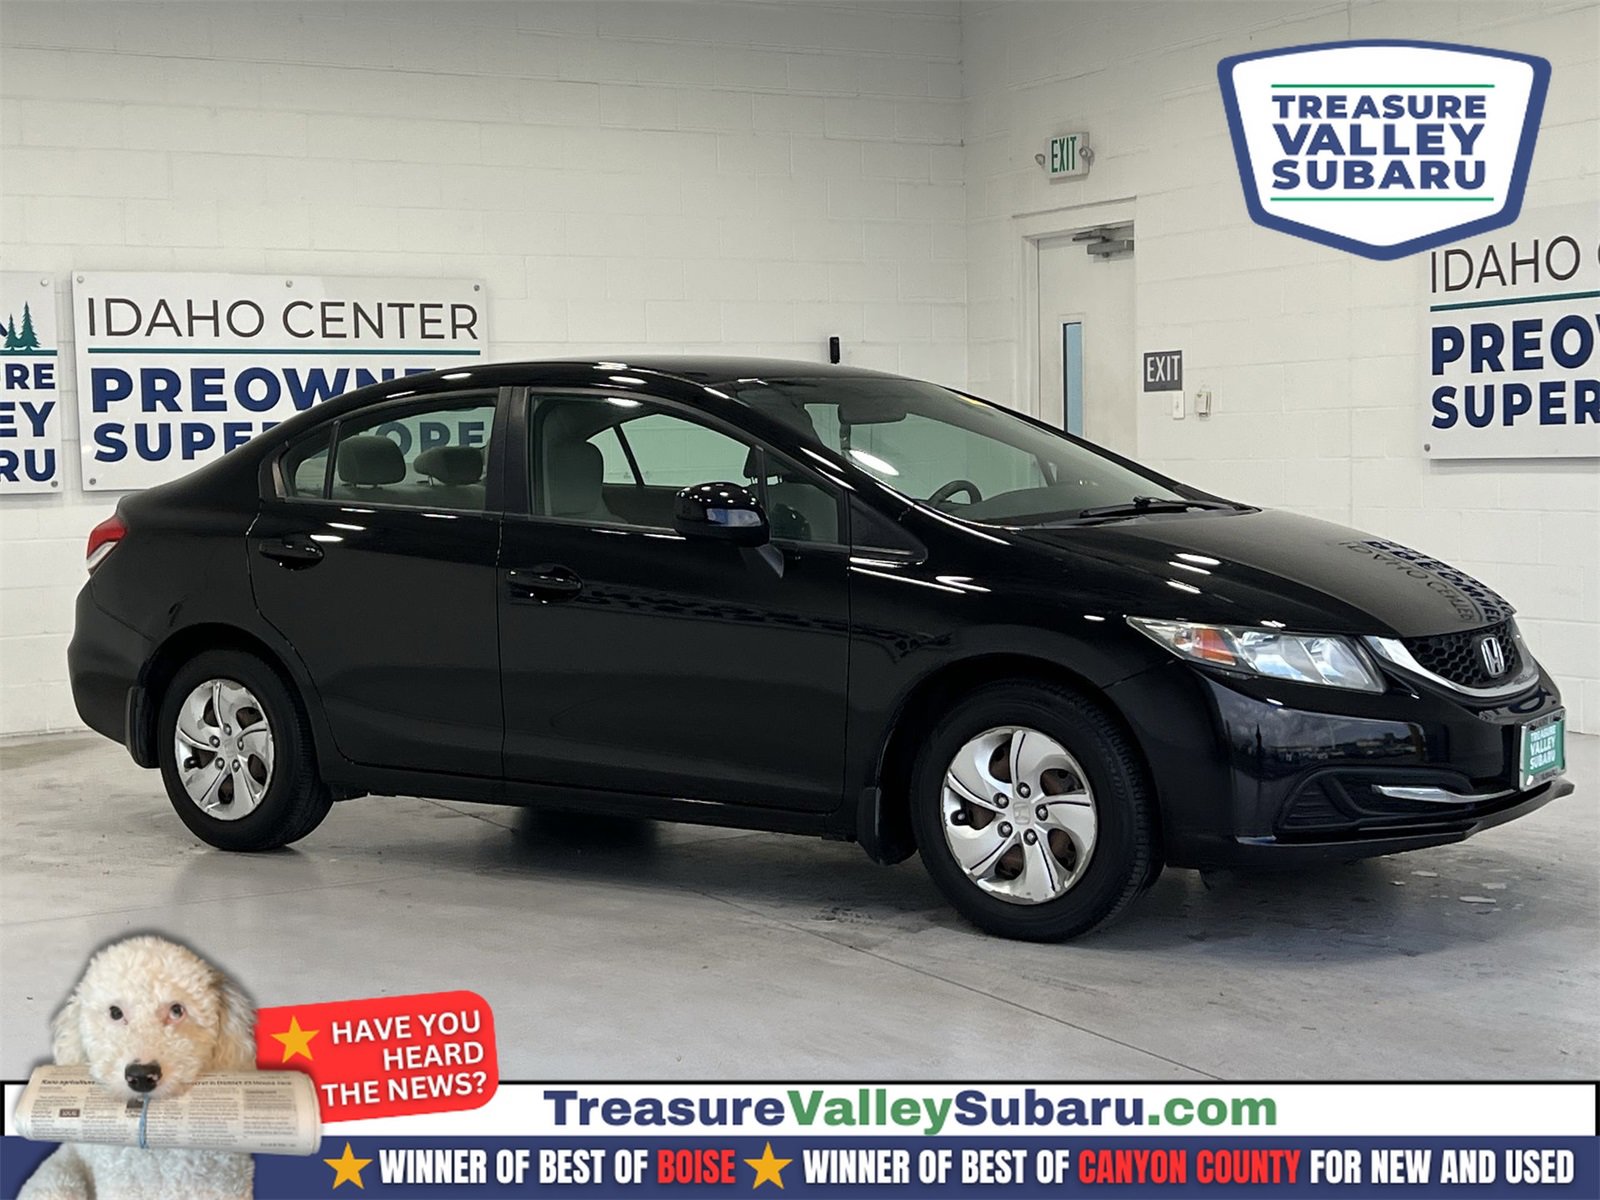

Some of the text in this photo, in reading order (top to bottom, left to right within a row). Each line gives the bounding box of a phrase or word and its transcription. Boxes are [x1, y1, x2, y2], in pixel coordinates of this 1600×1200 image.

[1051, 136, 1077, 173] EXIT
[1432, 235, 1581, 293] IDAHO
[88, 297, 478, 340] IDAHO CENTER
[1432, 314, 1600, 375] PREO
[0, 363, 55, 390] RE
[1147, 355, 1181, 382] EXIT
[1530, 735, 1556, 756] VALLEY
[1530, 749, 1556, 770] SUBARU
